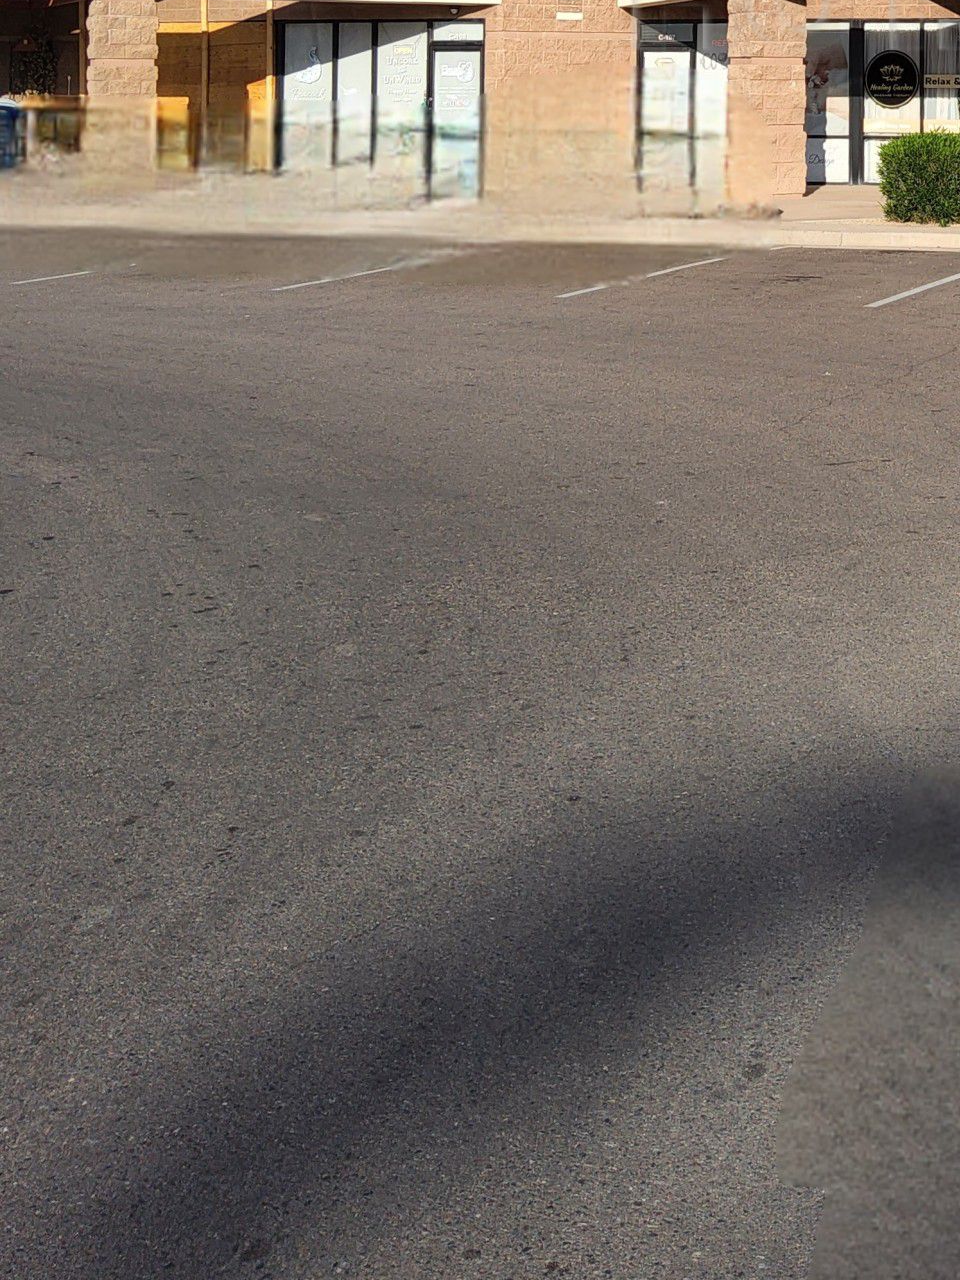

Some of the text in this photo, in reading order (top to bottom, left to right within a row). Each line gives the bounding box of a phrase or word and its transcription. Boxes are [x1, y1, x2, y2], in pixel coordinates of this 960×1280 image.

[925, 77, 951, 86] Relax
[954, 77, 960, 85] &
[870, 84, 891, 92] Healing
